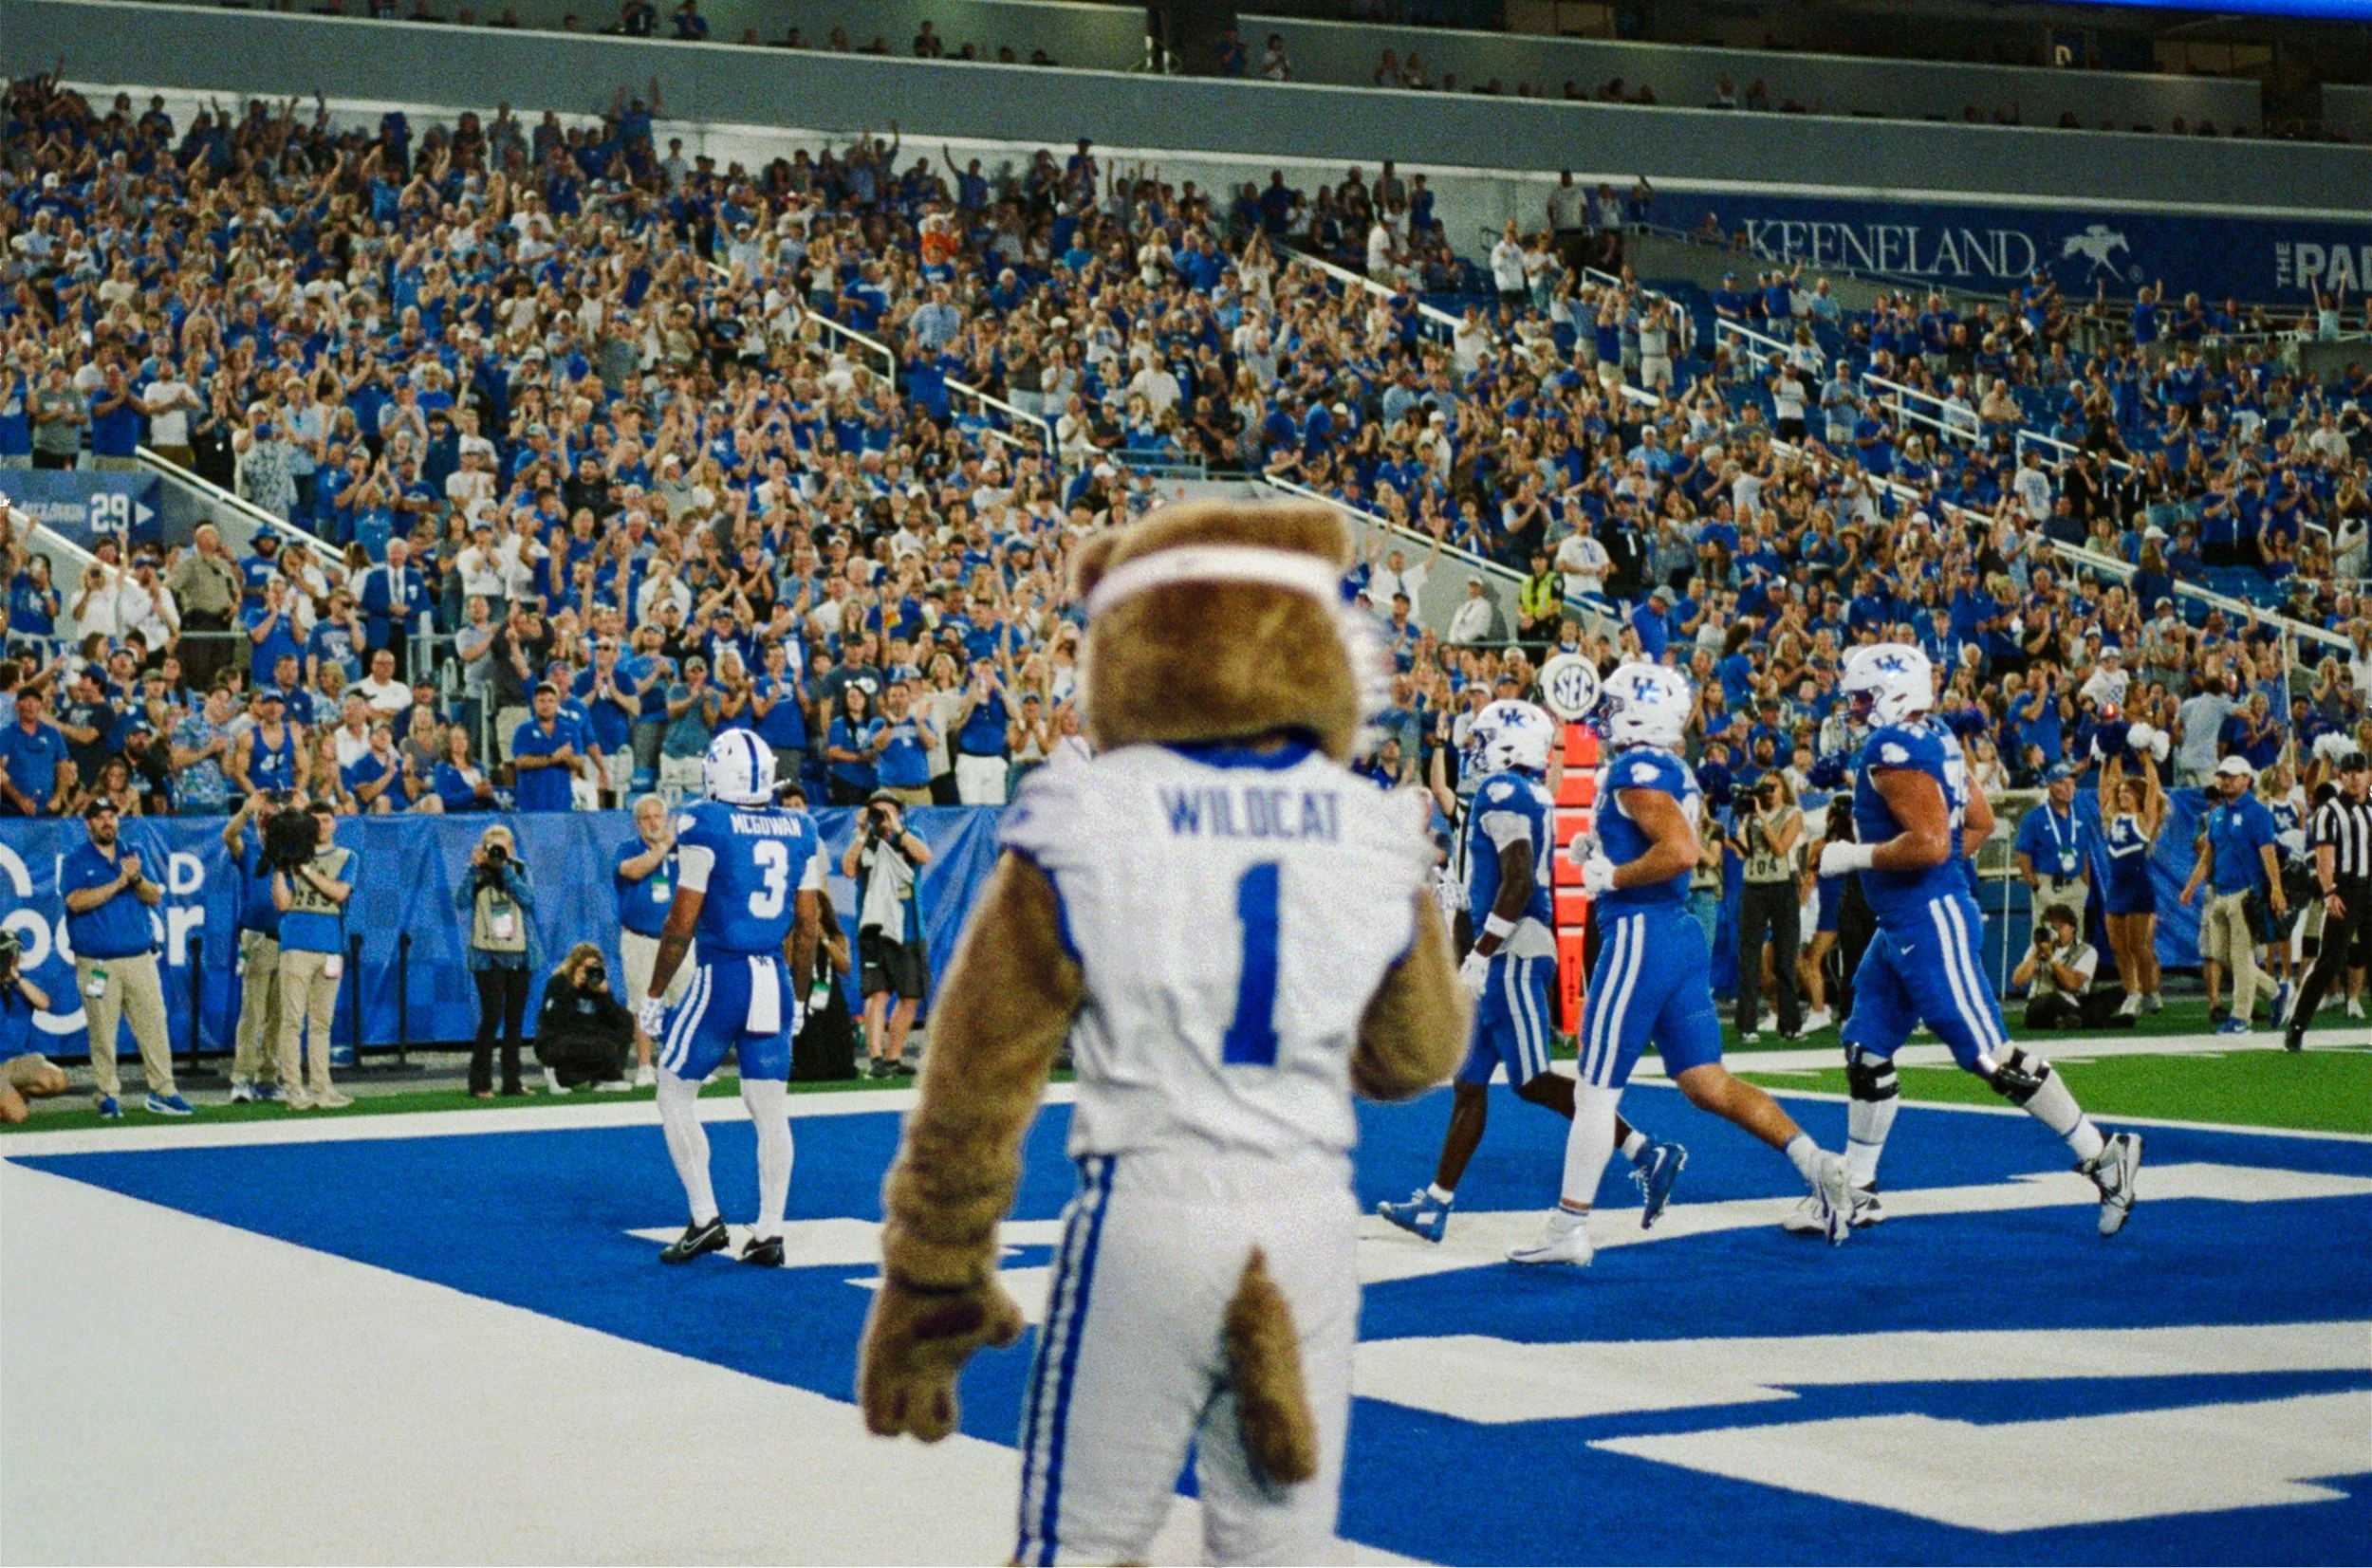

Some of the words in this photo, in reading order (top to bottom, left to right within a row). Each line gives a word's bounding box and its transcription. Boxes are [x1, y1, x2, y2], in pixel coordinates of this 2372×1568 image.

[1743, 219, 2037, 278] KEENELAND
[2276, 242, 2290, 288] THE
[91, 493, 129, 532] 29
[1160, 787, 1342, 842] WILDCAT
[749, 839, 788, 918] 3
[1222, 861, 1280, 1066] 1
